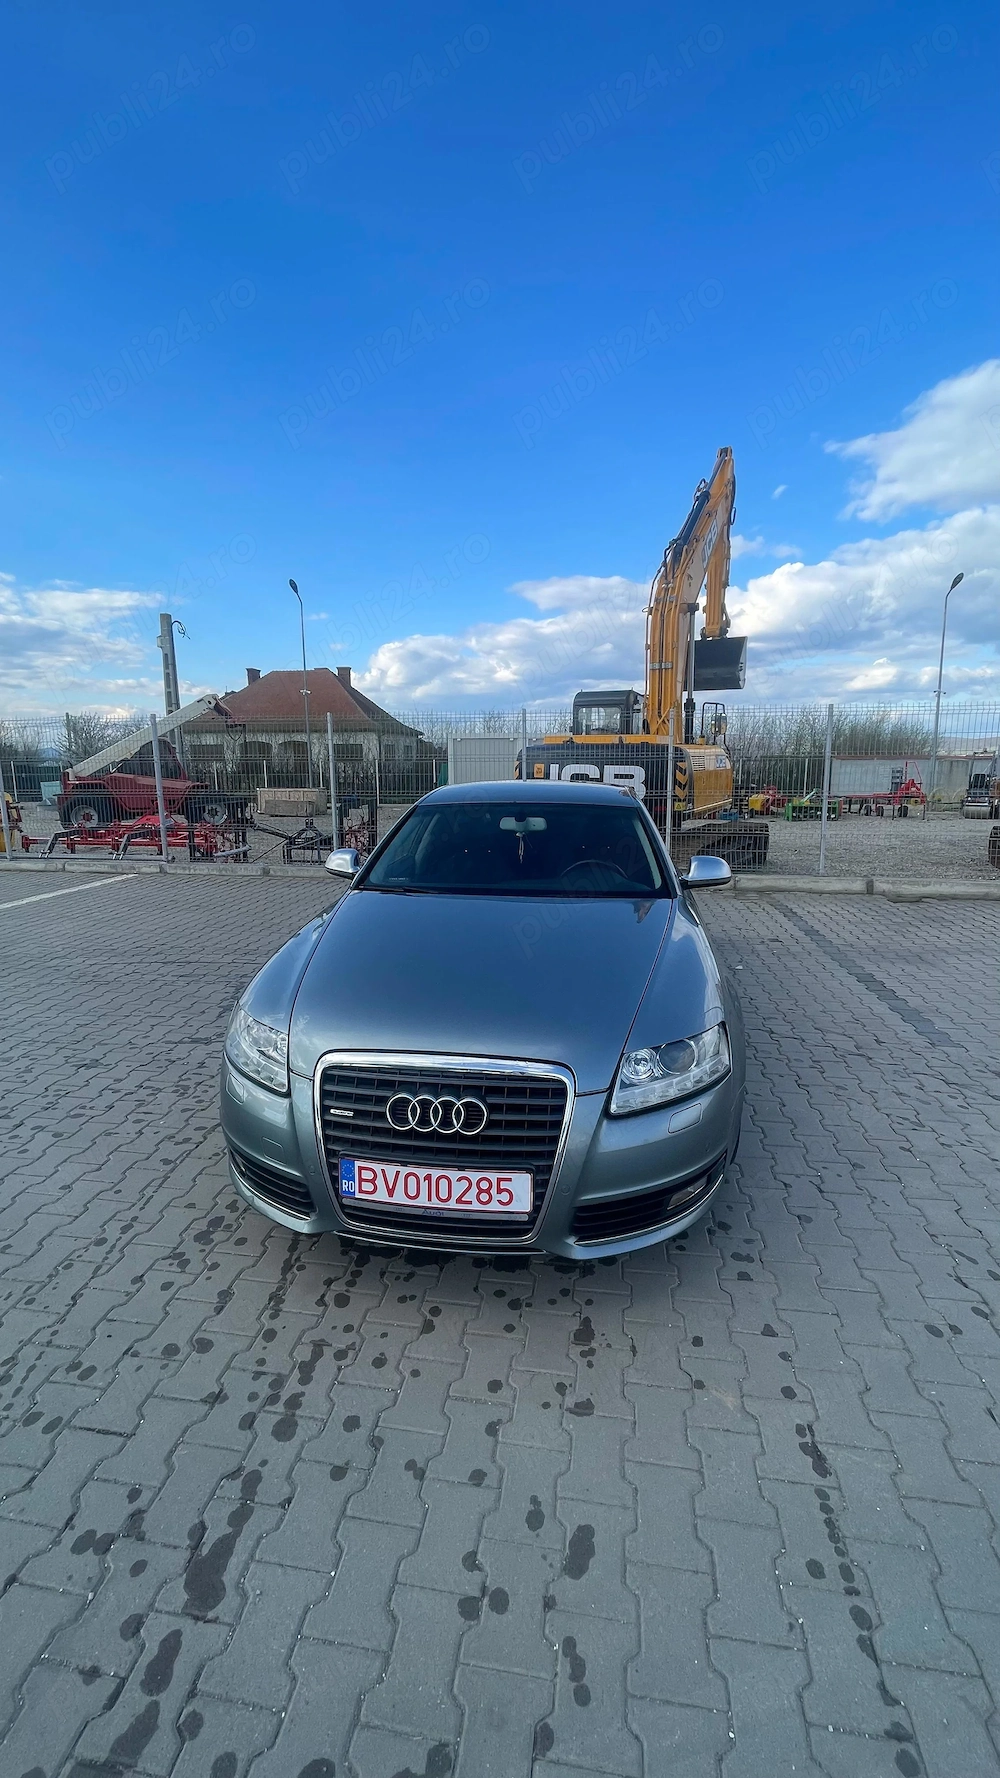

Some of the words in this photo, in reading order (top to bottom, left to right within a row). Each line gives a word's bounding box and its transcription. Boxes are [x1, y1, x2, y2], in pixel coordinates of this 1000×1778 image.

[703, 519, 718, 568] JCB
[342, 1180, 355, 1193] RO
[357, 1165, 514, 1206] BV010285
[421, 1209, 445, 1217] Audi
